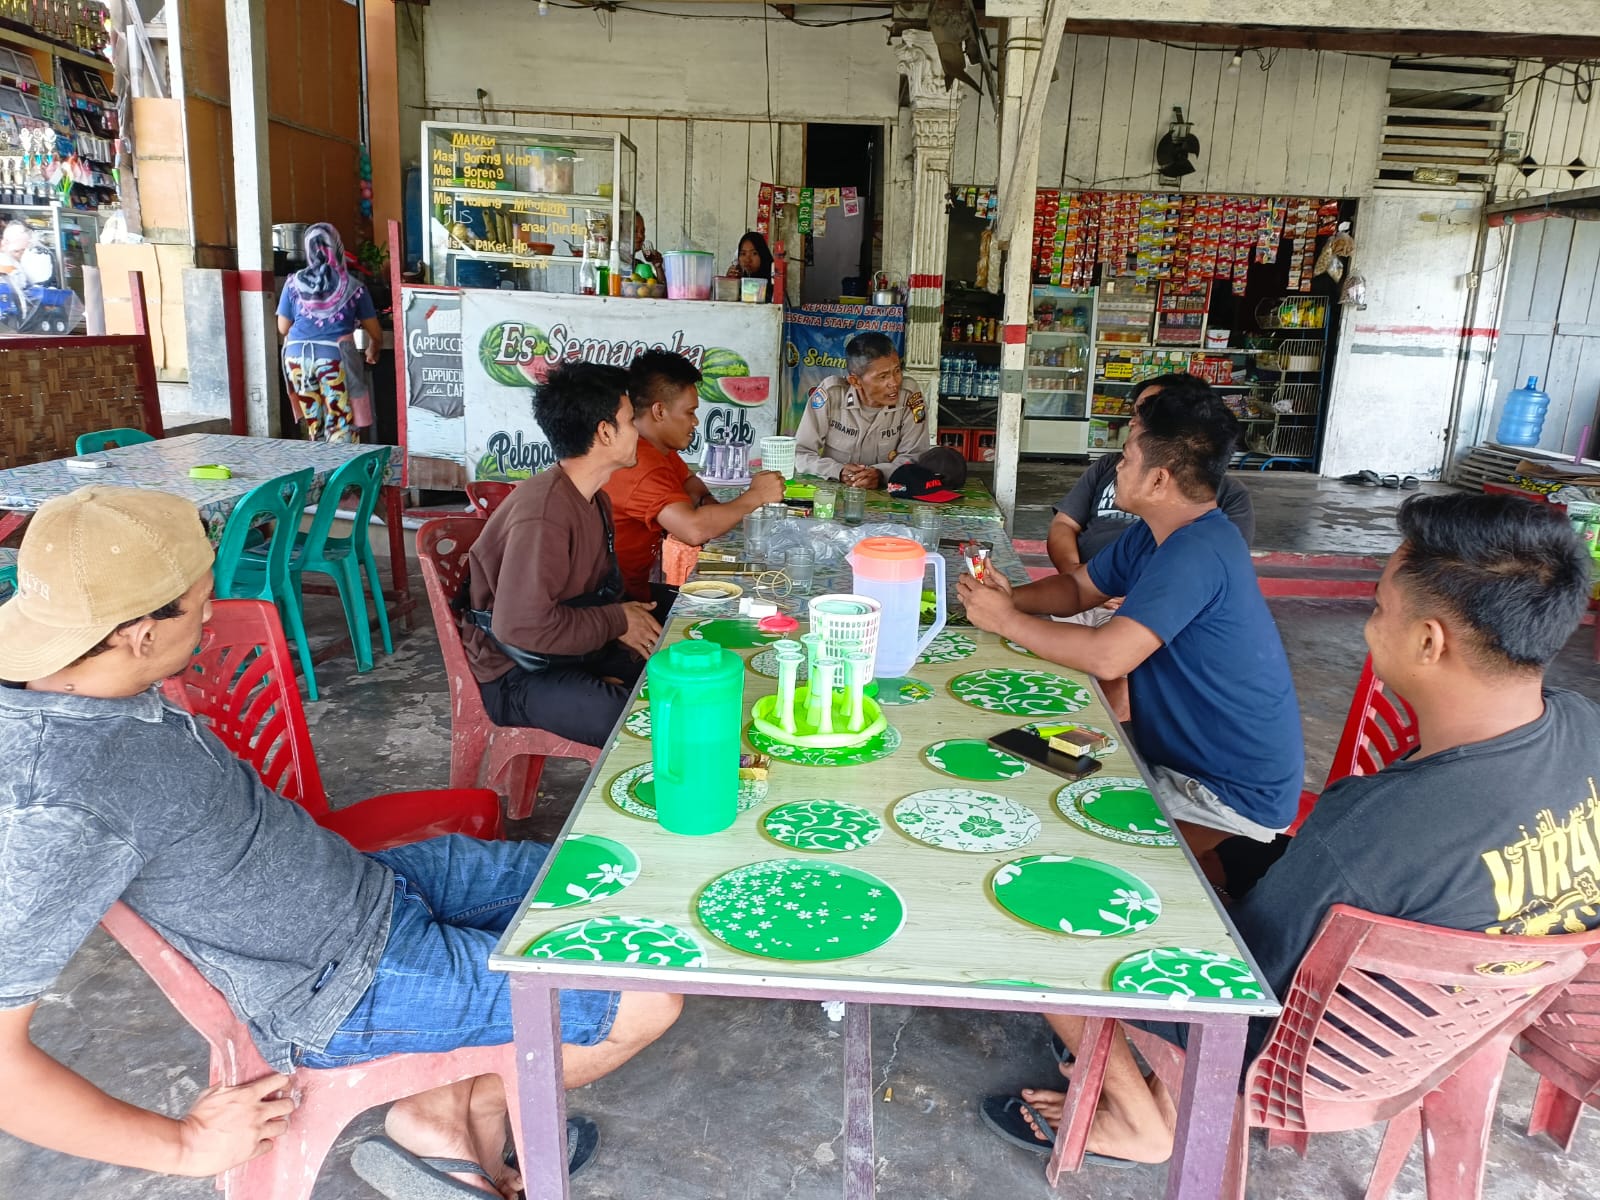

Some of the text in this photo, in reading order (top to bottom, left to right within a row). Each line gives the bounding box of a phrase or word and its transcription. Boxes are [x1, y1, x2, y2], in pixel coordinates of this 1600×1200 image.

[463, 152, 501, 165] goreng
[433, 164, 504, 179] Mie goreng
[433, 177, 497, 189] mie rebus
[433, 191, 452, 205] Mie
[802, 304, 903, 317] KEPOLISIAN SEKTOR
[823, 317, 854, 329] STAFF
[856, 320, 880, 331] DAN
[881, 321, 904, 332] BHA
[495, 322, 536, 365] Es
[426, 384, 442, 394] ala
